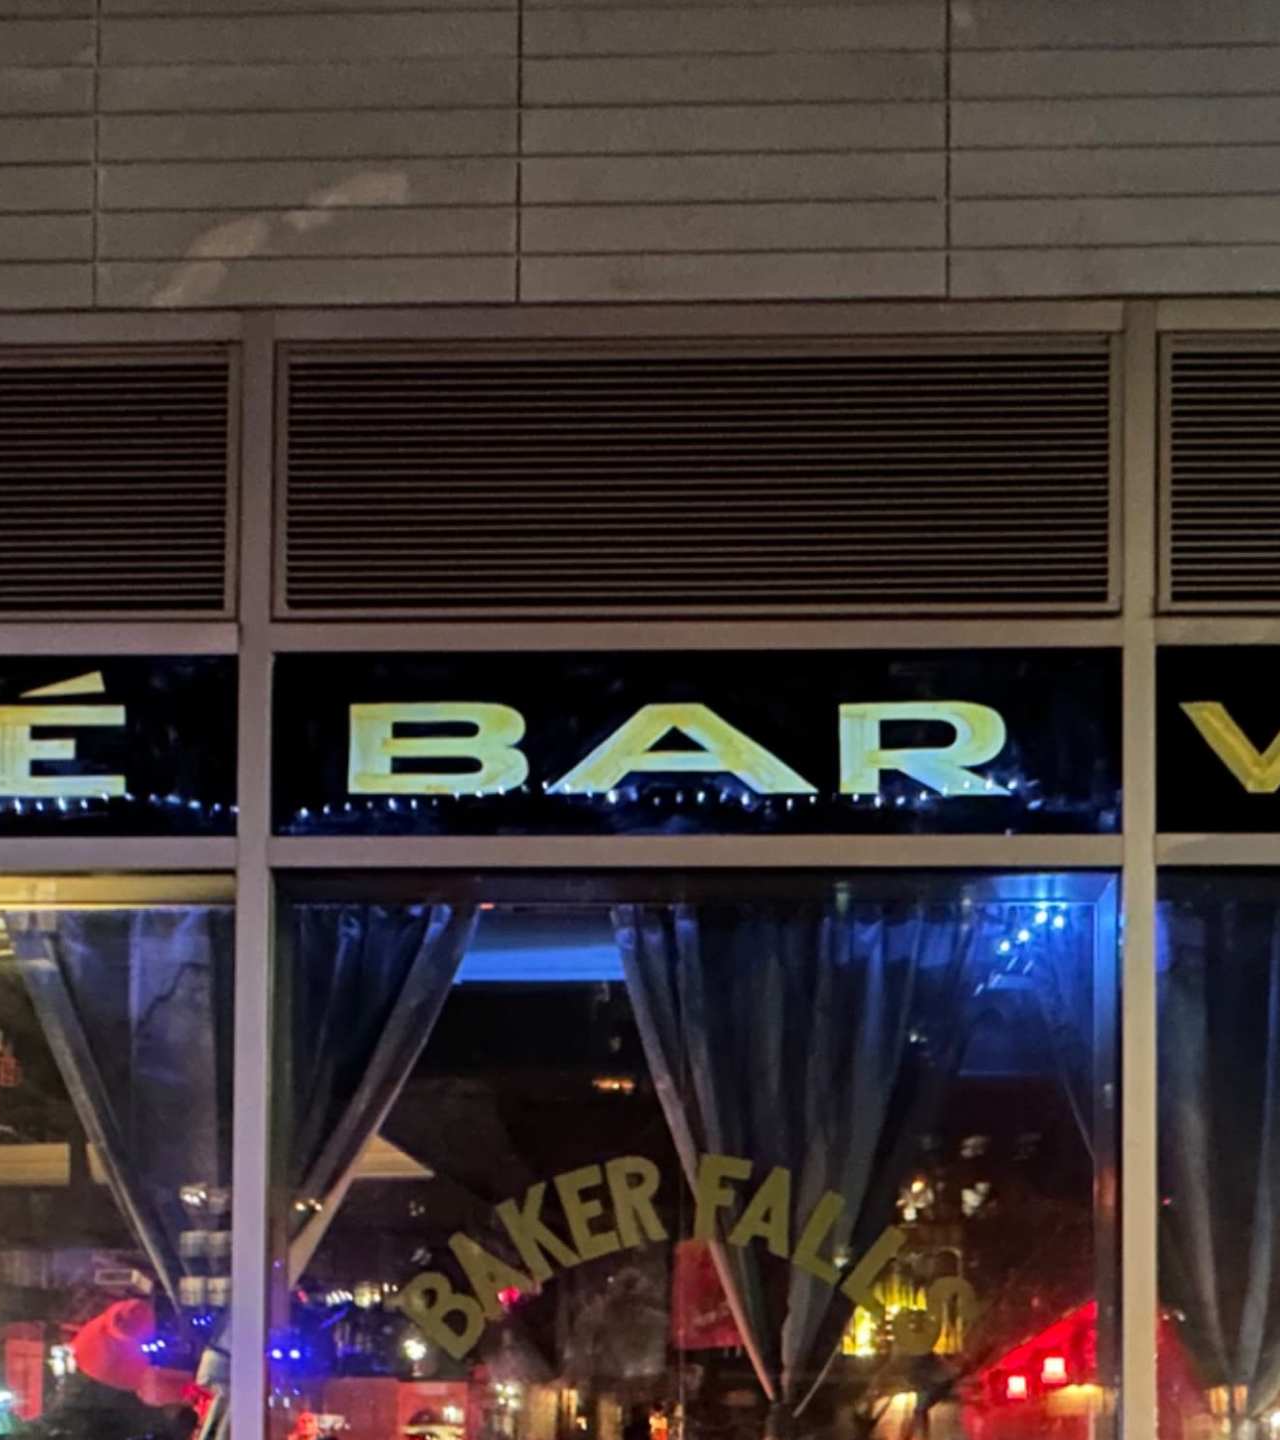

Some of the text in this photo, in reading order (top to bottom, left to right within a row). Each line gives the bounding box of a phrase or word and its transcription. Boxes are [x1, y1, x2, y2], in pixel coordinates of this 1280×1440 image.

[345, 700, 1013, 796] BAR
[399, 1153, 981, 1360] BAKER FALLS
